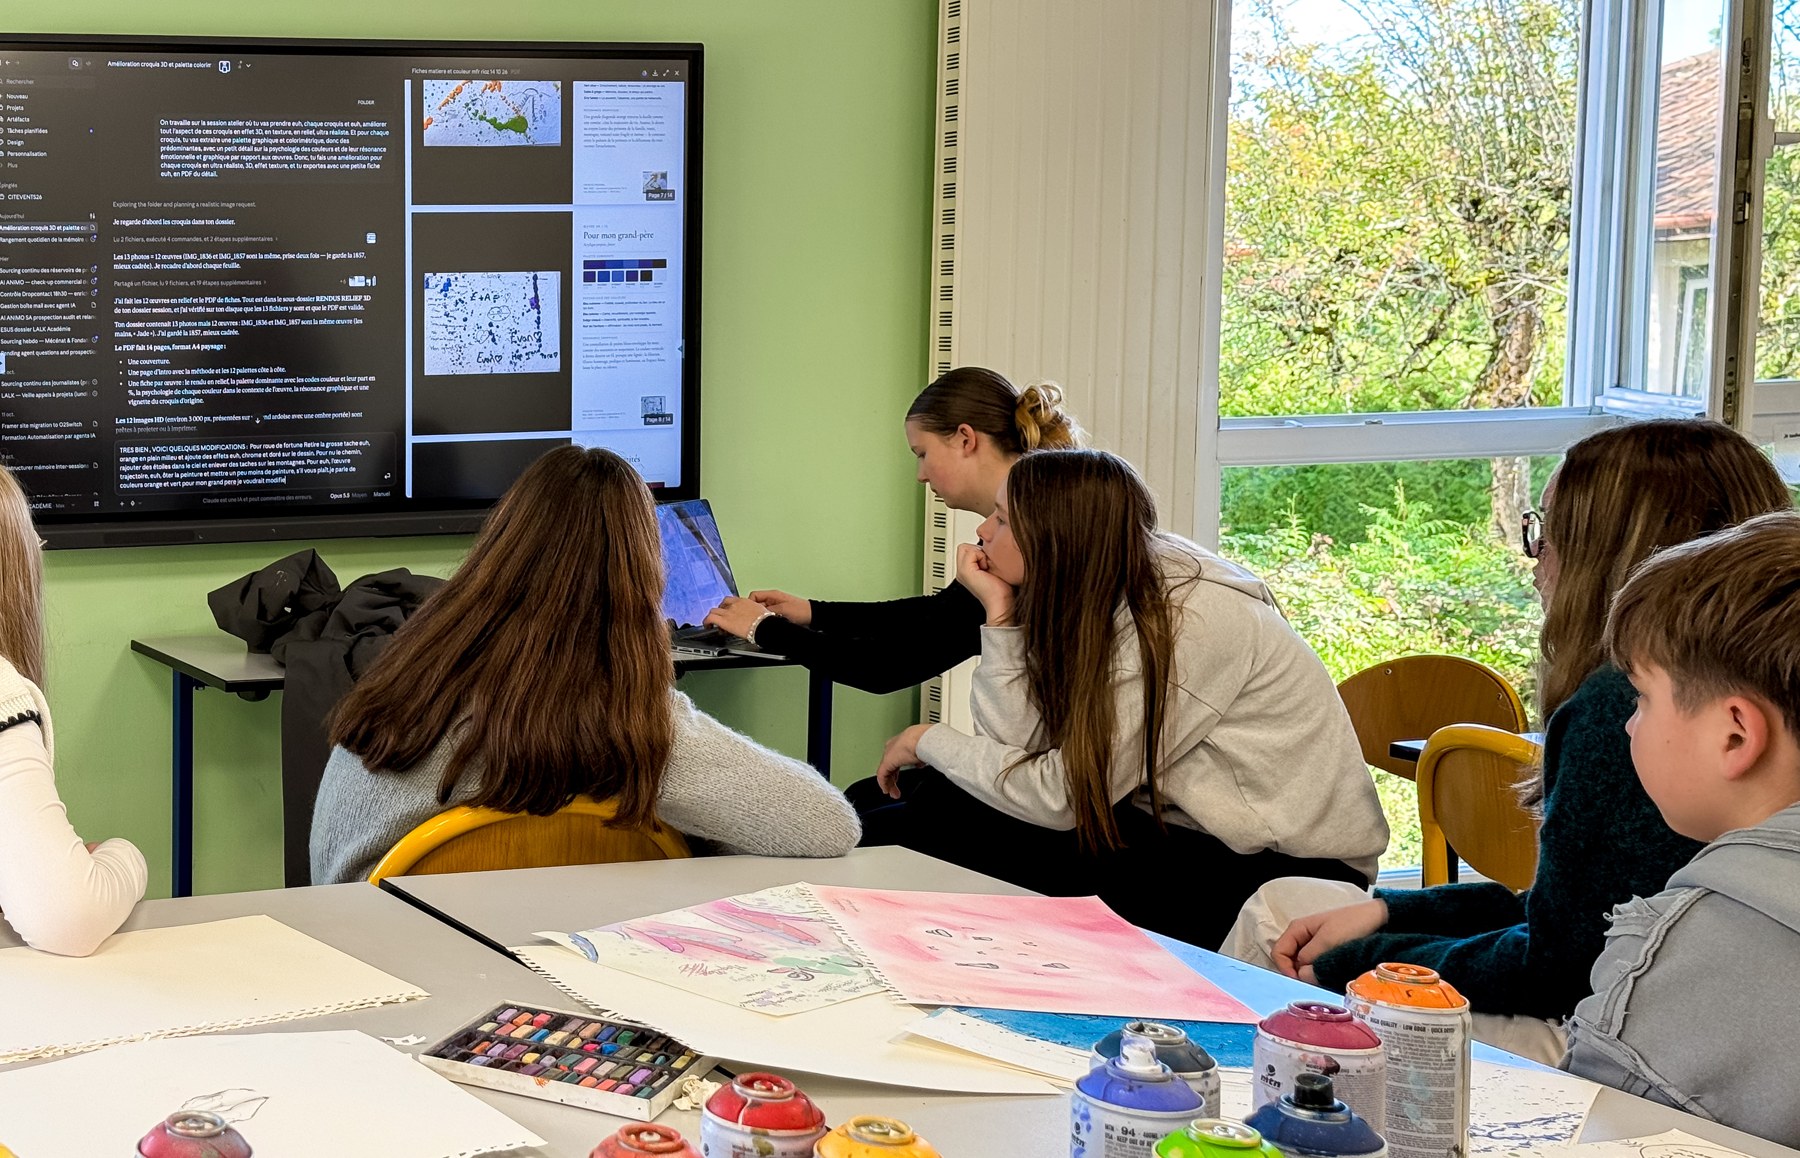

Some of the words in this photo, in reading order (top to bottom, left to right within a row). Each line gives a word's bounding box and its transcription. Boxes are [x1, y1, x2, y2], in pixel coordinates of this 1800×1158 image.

[270, 120, 291, 128] prendre
[292, 120, 303, 128] euh,
[304, 120, 324, 128] chaque
[324, 120, 344, 128] croquis
[350, 120, 362, 128] euh,
[172, 127, 194, 136] l'aspect
[213, 128, 233, 136] croquis
[272, 128, 293, 136] texture,
[370, 128, 389, 137] chaque
[160, 136, 182, 144] croquis,
[232, 136, 251, 144] palette
[252, 136, 279, 145] graphique
[618, 230, 654, 241] grand-père
[169, 444, 200, 453] QUELQUES
[359, 440, 370, 448] euh,
[208, 479, 224, 487] grand
[237, 478, 242, 486] je
[1121, 1126, 1135, 1137] 94
